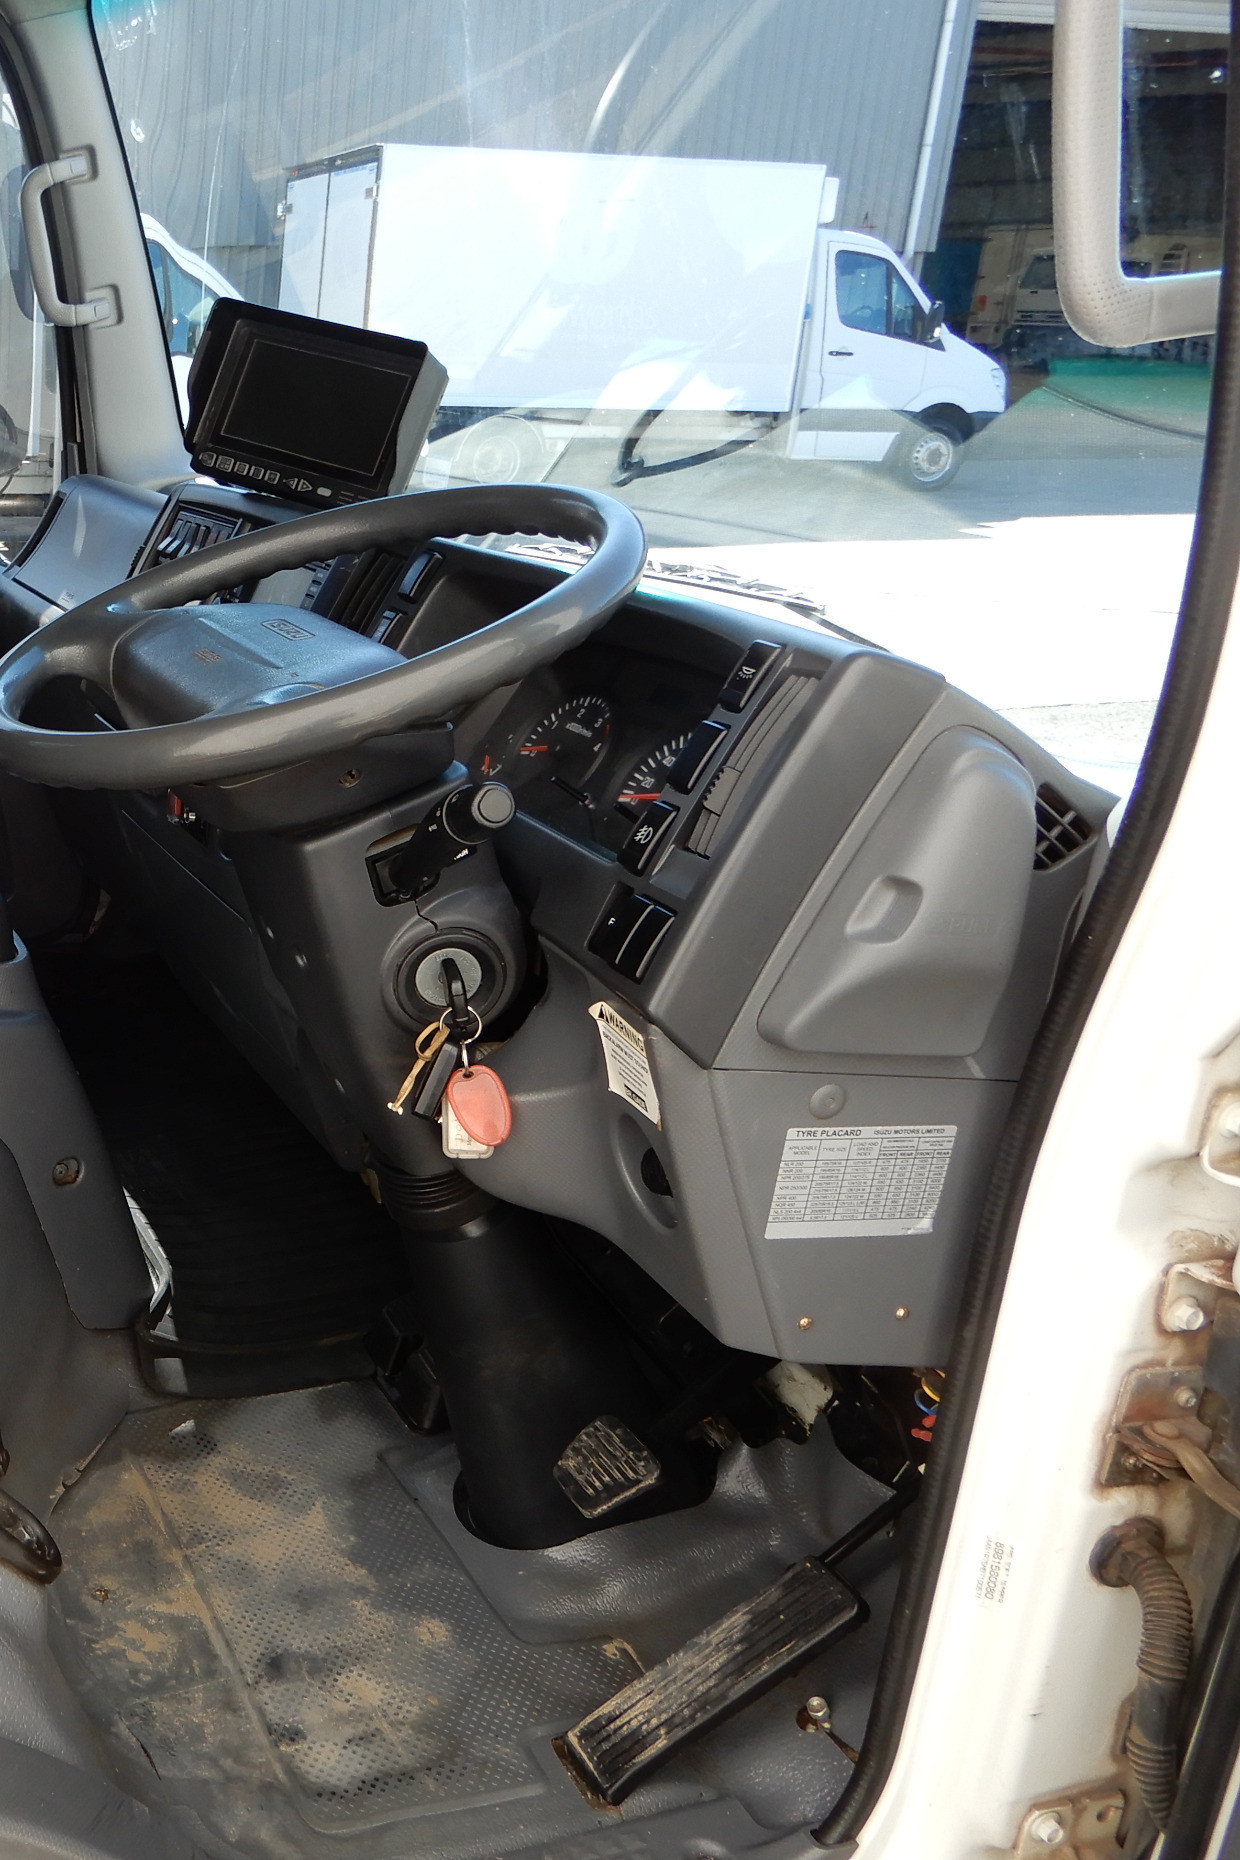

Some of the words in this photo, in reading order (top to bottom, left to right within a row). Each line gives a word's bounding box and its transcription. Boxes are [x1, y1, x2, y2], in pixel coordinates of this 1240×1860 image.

[577, 708, 586, 718] 2
[594, 718, 603, 728] 3
[592, 742, 602, 752] 4
[641, 776, 655, 788] 20
[608, 917, 616, 925] F
[608, 1009, 644, 1052] WARNING
[985, 1541, 1005, 1600] 8981580080
